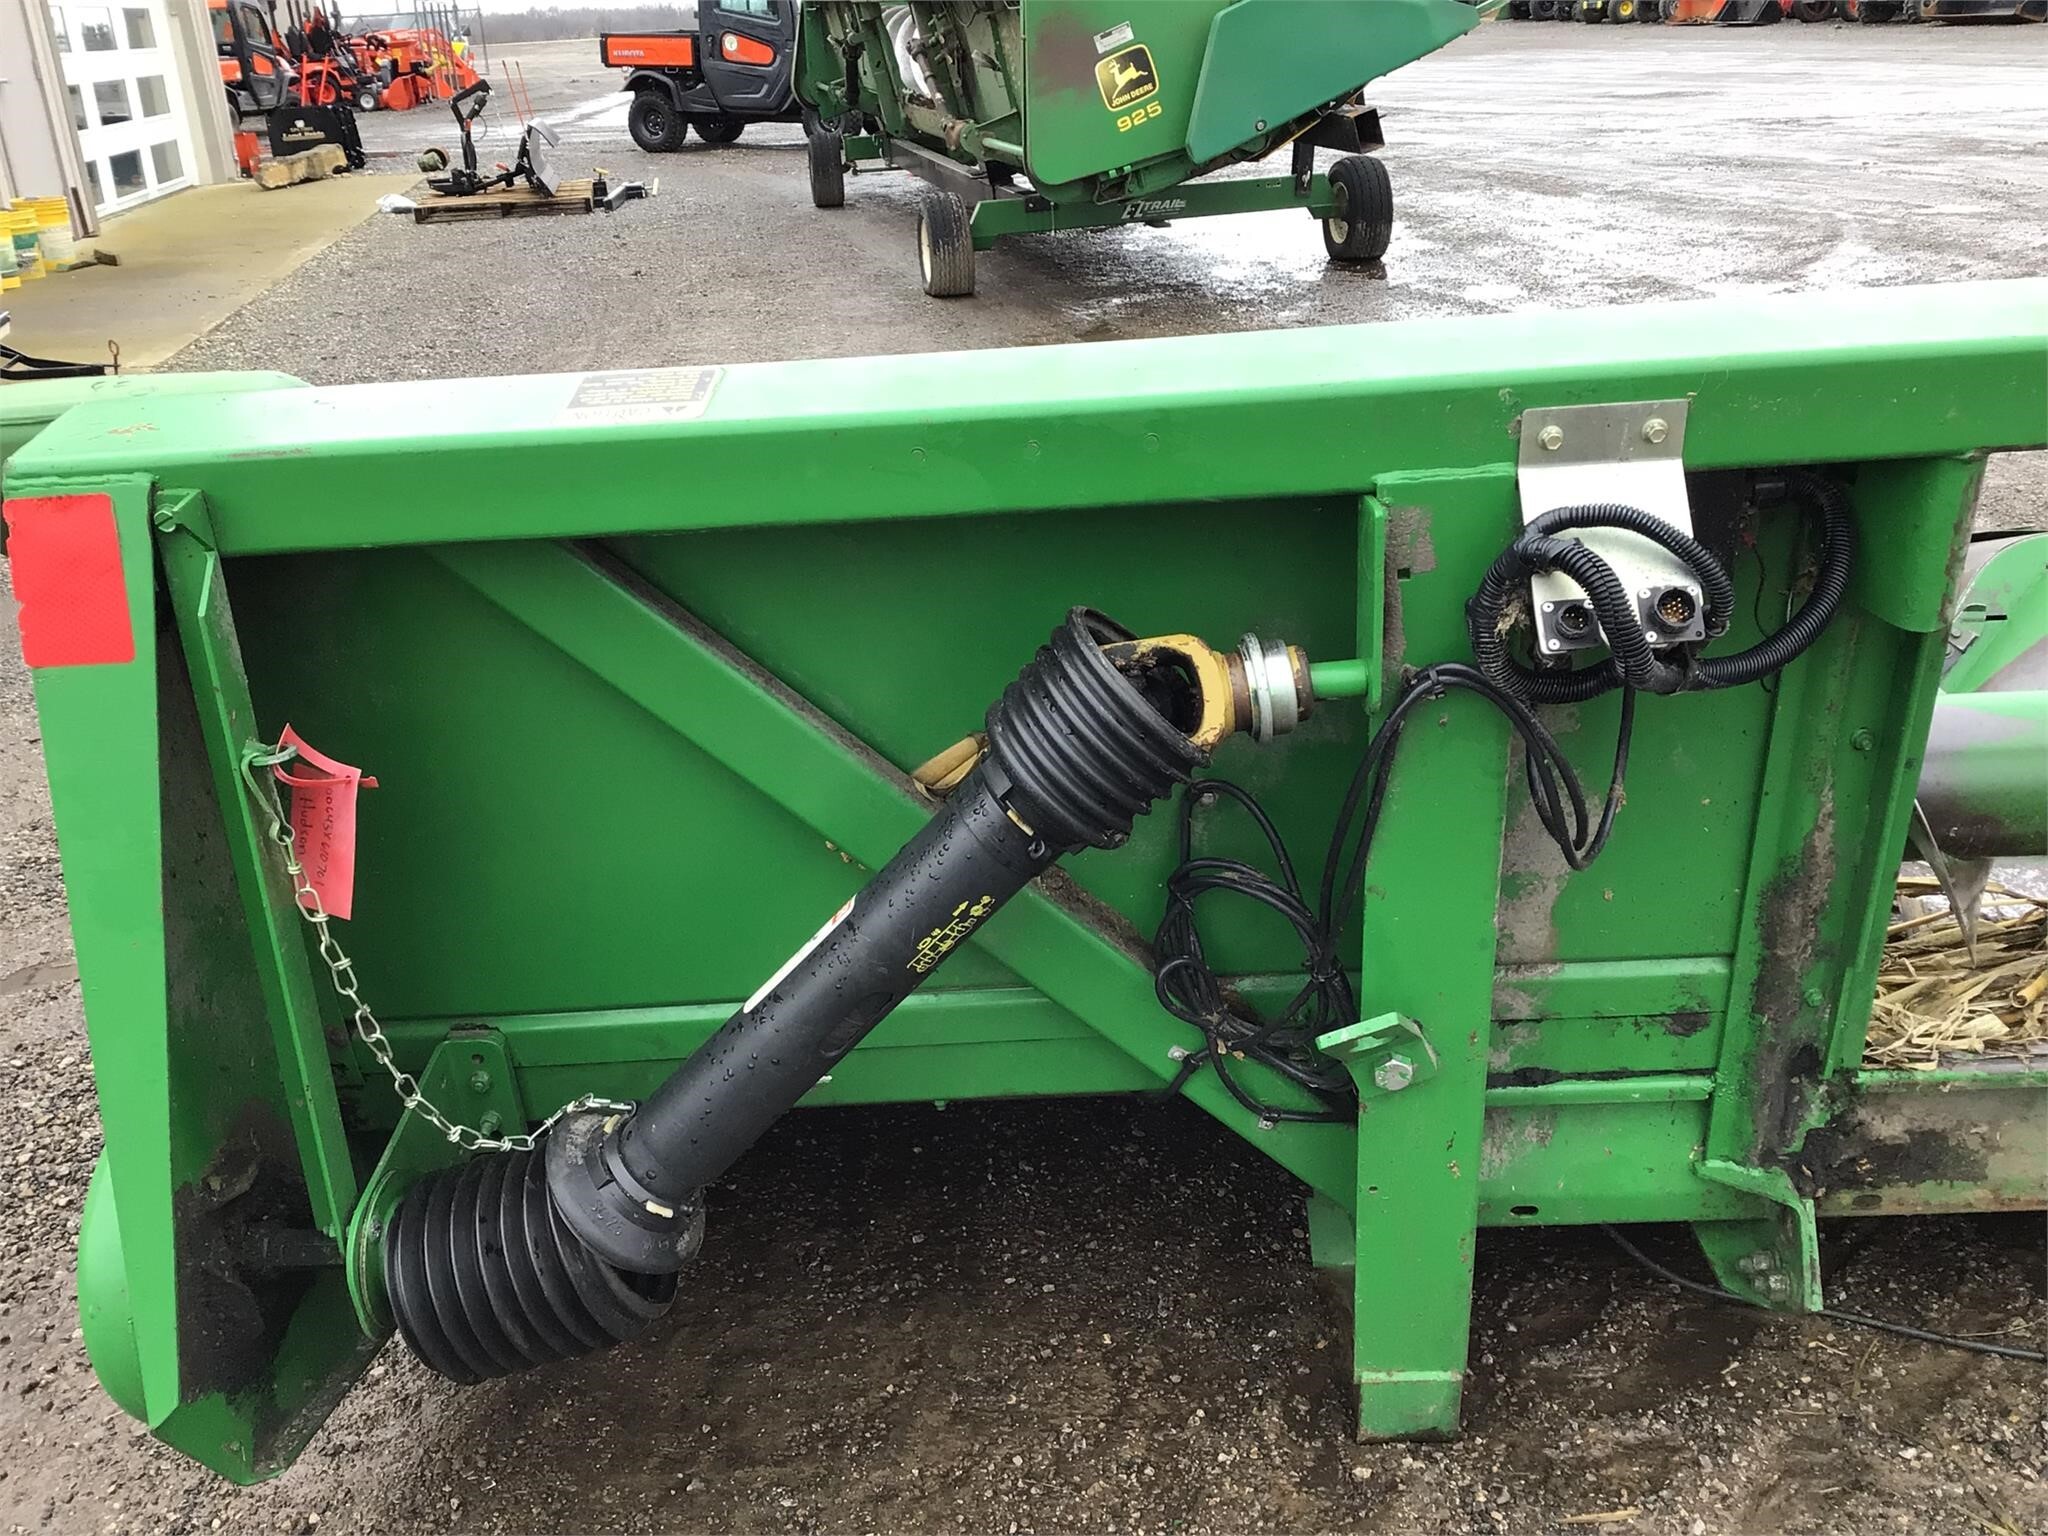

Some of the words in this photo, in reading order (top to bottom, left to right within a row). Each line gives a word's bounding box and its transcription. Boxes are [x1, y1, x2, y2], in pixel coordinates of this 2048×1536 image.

[613, 49, 645, 58] KUBOTA
[1111, 92, 1131, 107] JOHN
[1130, 82, 1154, 99] DEERE
[1116, 100, 1163, 132] 925
[299, 797, 316, 855] Hudson
